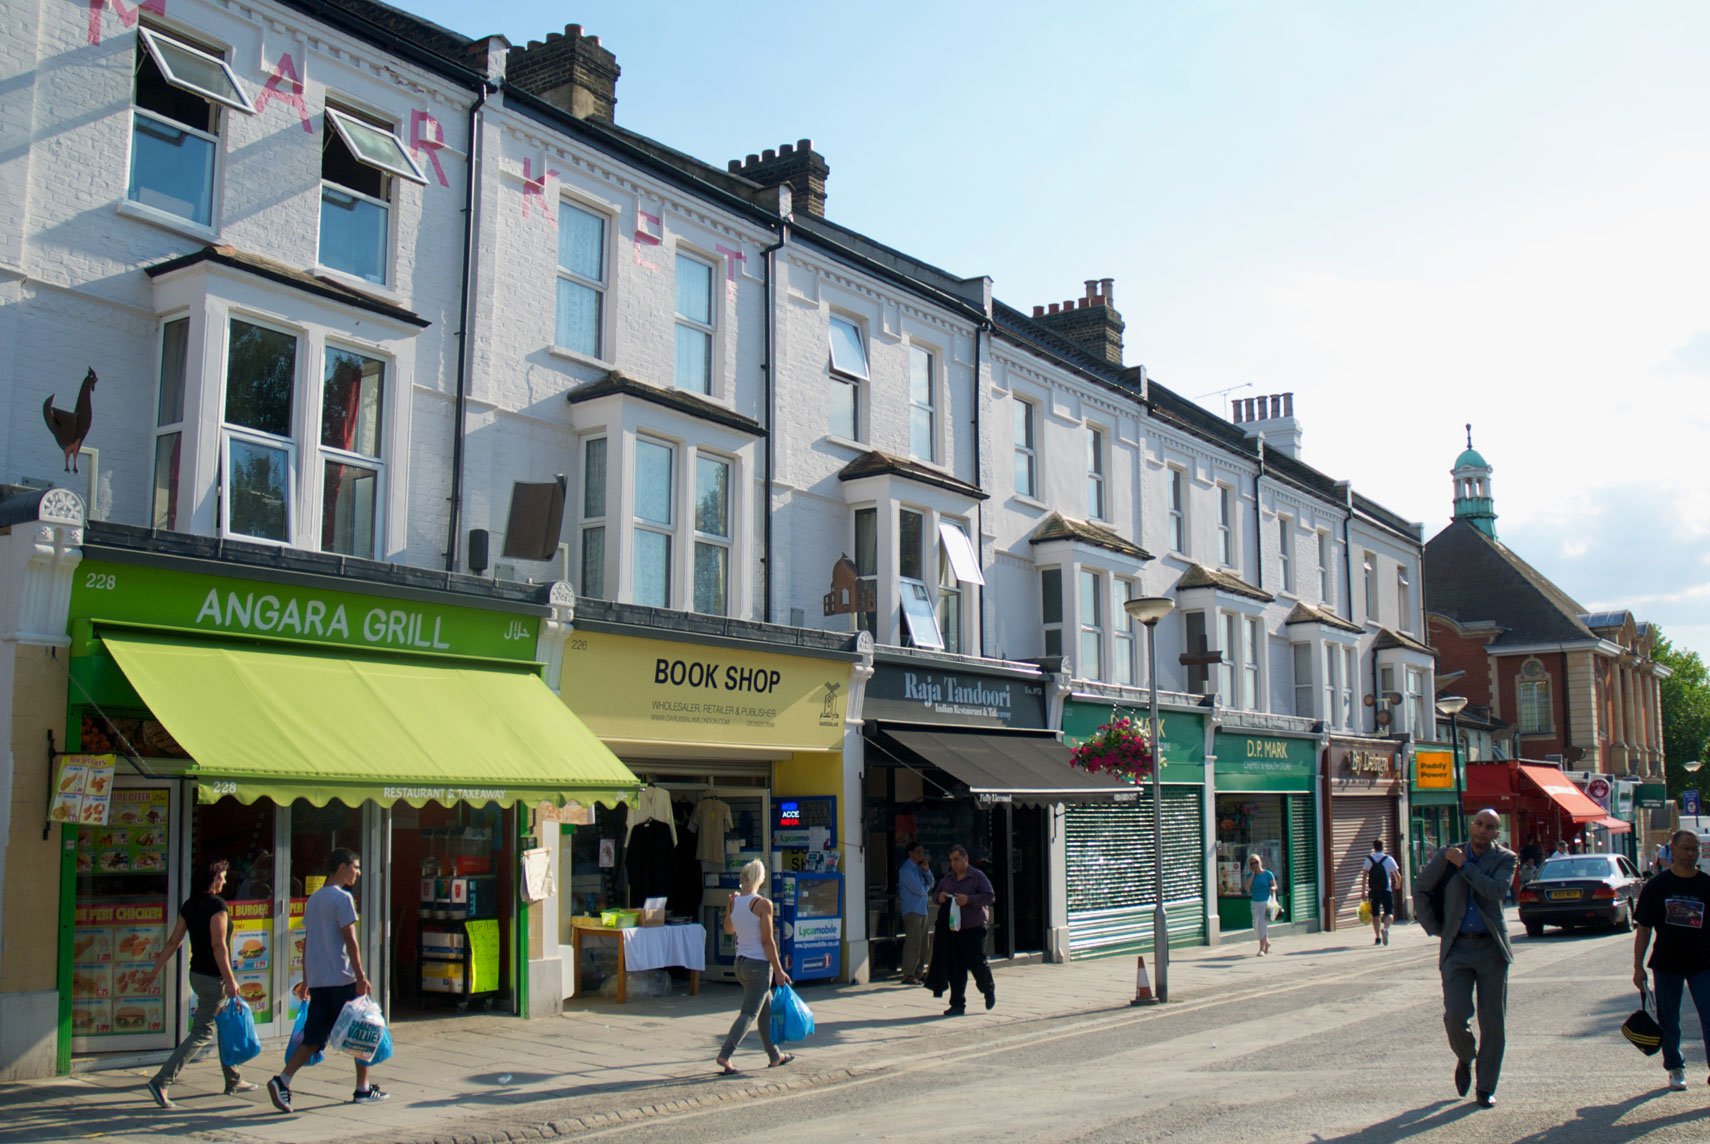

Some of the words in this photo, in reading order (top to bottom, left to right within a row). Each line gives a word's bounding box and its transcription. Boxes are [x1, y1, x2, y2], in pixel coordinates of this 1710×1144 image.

[86, 573, 116, 590] 228
[196, 587, 350, 639] ANGARA
[363, 608, 450, 649] GRILL
[571, 639, 588, 651] 226
[654, 658, 719, 689] BOOK
[724, 666, 781, 694] SHOP
[904, 672, 942, 708] Raja
[943, 676, 1011, 708] Tandoori
[651, 700, 702, 714] WHOLESALER,
[703, 704, 734, 715] RETAILER
[735, 706, 740, 716] &
[741, 706, 777, 718] PUBLISHER
[935, 702, 953, 714] Indian
[953, 704, 982, 716] Restaurant
[982, 707, 988, 717] &
[1246, 739, 1263, 758] D.P.
[1264, 741, 1288, 759] MARK
[1420, 762, 1447, 770] Paddy
[213, 781, 237, 794] 228
[383, 786, 445, 799] RESTAURANT
[447, 787, 455, 799] &
[457, 788, 506, 800] TAKEAWAY
[979, 793, 992, 804] Fully
[782, 810, 800, 818] ACCE
[116, 906, 162, 920] CHICKEN
[235, 903, 269, 916] BURGER
[798, 924, 838, 938] Lycamobile
